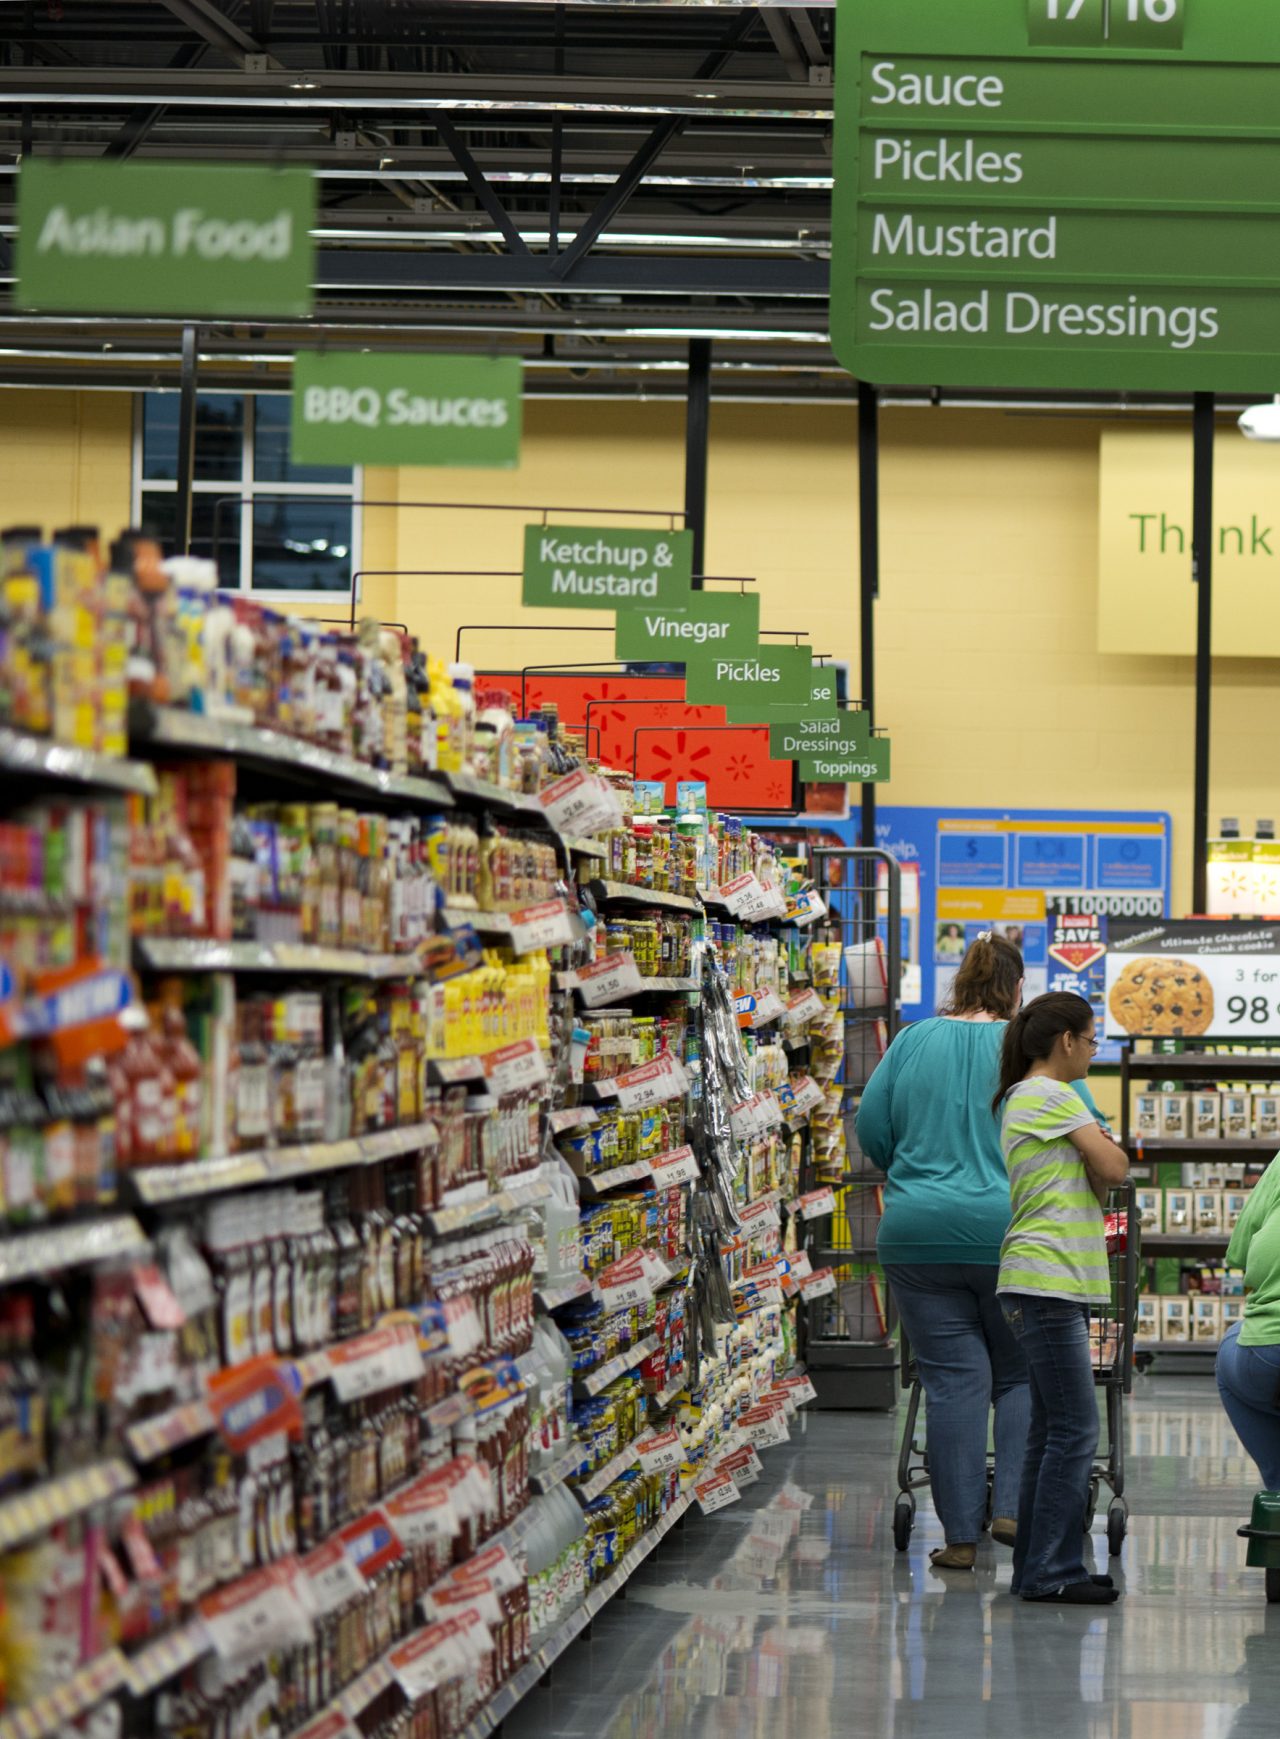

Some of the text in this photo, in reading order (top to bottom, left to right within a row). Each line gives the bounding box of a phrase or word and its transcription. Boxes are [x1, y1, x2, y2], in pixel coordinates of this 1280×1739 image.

[870, 62, 1003, 107] Sauce
[874, 138, 1022, 183] Pickles
[38, 207, 292, 261] Asian Food
[871, 214, 1057, 259] Mustard
[869, 289, 1218, 348] Salad Dressings
[304, 386, 507, 427] BBQ Sauces
[1129, 513, 1273, 556] Thnk
[540, 539, 673, 571] Ketchup &
[552, 570, 658, 597] Mustard
[645, 617, 730, 643] Vinegar
[716, 663, 780, 682] Pickles
[800, 719, 840, 733] Salad
[783, 737, 856, 754] Dressings
[813, 760, 877, 777] Toppings
[1054, 928, 1100, 942] SAVE
[1161, 931, 1273, 949] Ultimate Chocolate
[1197, 942, 1236, 954] Chunk
[1235, 968, 1278, 982] 3 for
